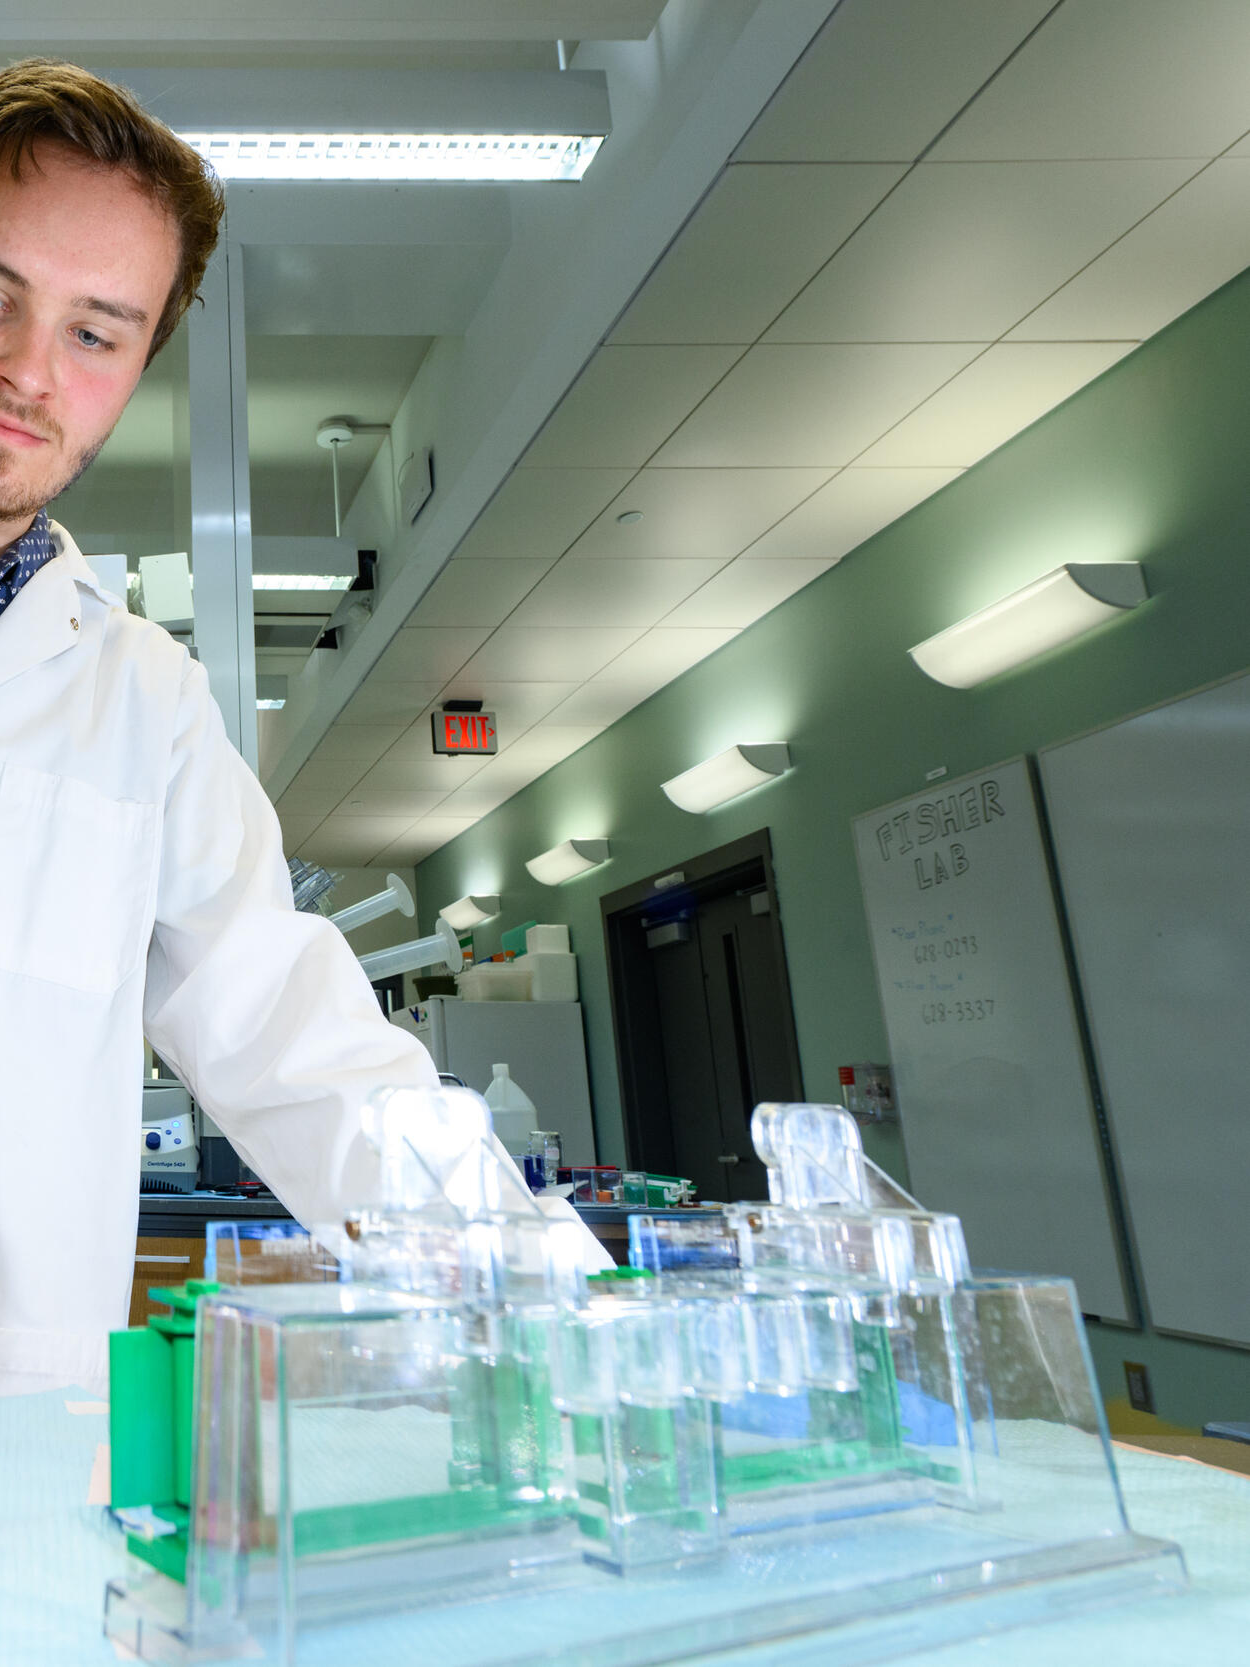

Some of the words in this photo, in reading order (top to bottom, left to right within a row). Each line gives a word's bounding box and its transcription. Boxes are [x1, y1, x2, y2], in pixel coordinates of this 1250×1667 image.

[444, 715, 489, 749] EXIT
[876, 780, 1006, 862] FISHER
[914, 842, 970, 890] LAB
